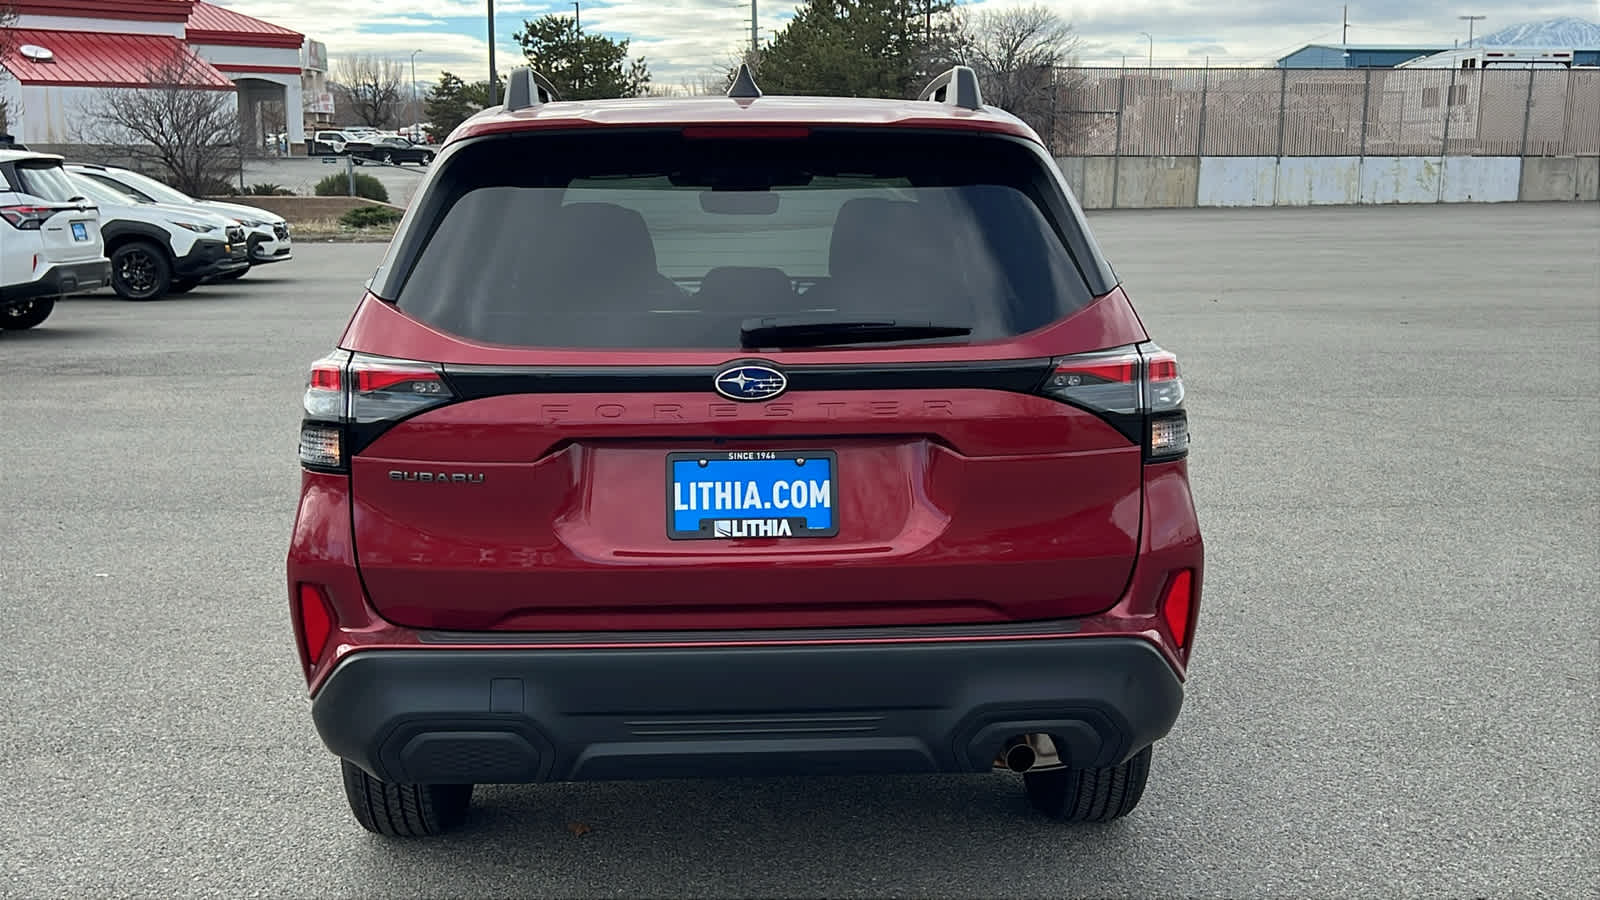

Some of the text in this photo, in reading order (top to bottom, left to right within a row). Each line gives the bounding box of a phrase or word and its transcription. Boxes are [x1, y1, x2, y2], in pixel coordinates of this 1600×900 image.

[540, 400, 953, 420] FORESTER
[728, 451, 776, 460] SINCE 1946
[388, 470, 485, 484] SUBARU
[674, 480, 831, 511] LITHIA.COM
[731, 519, 792, 537] LITHIA
